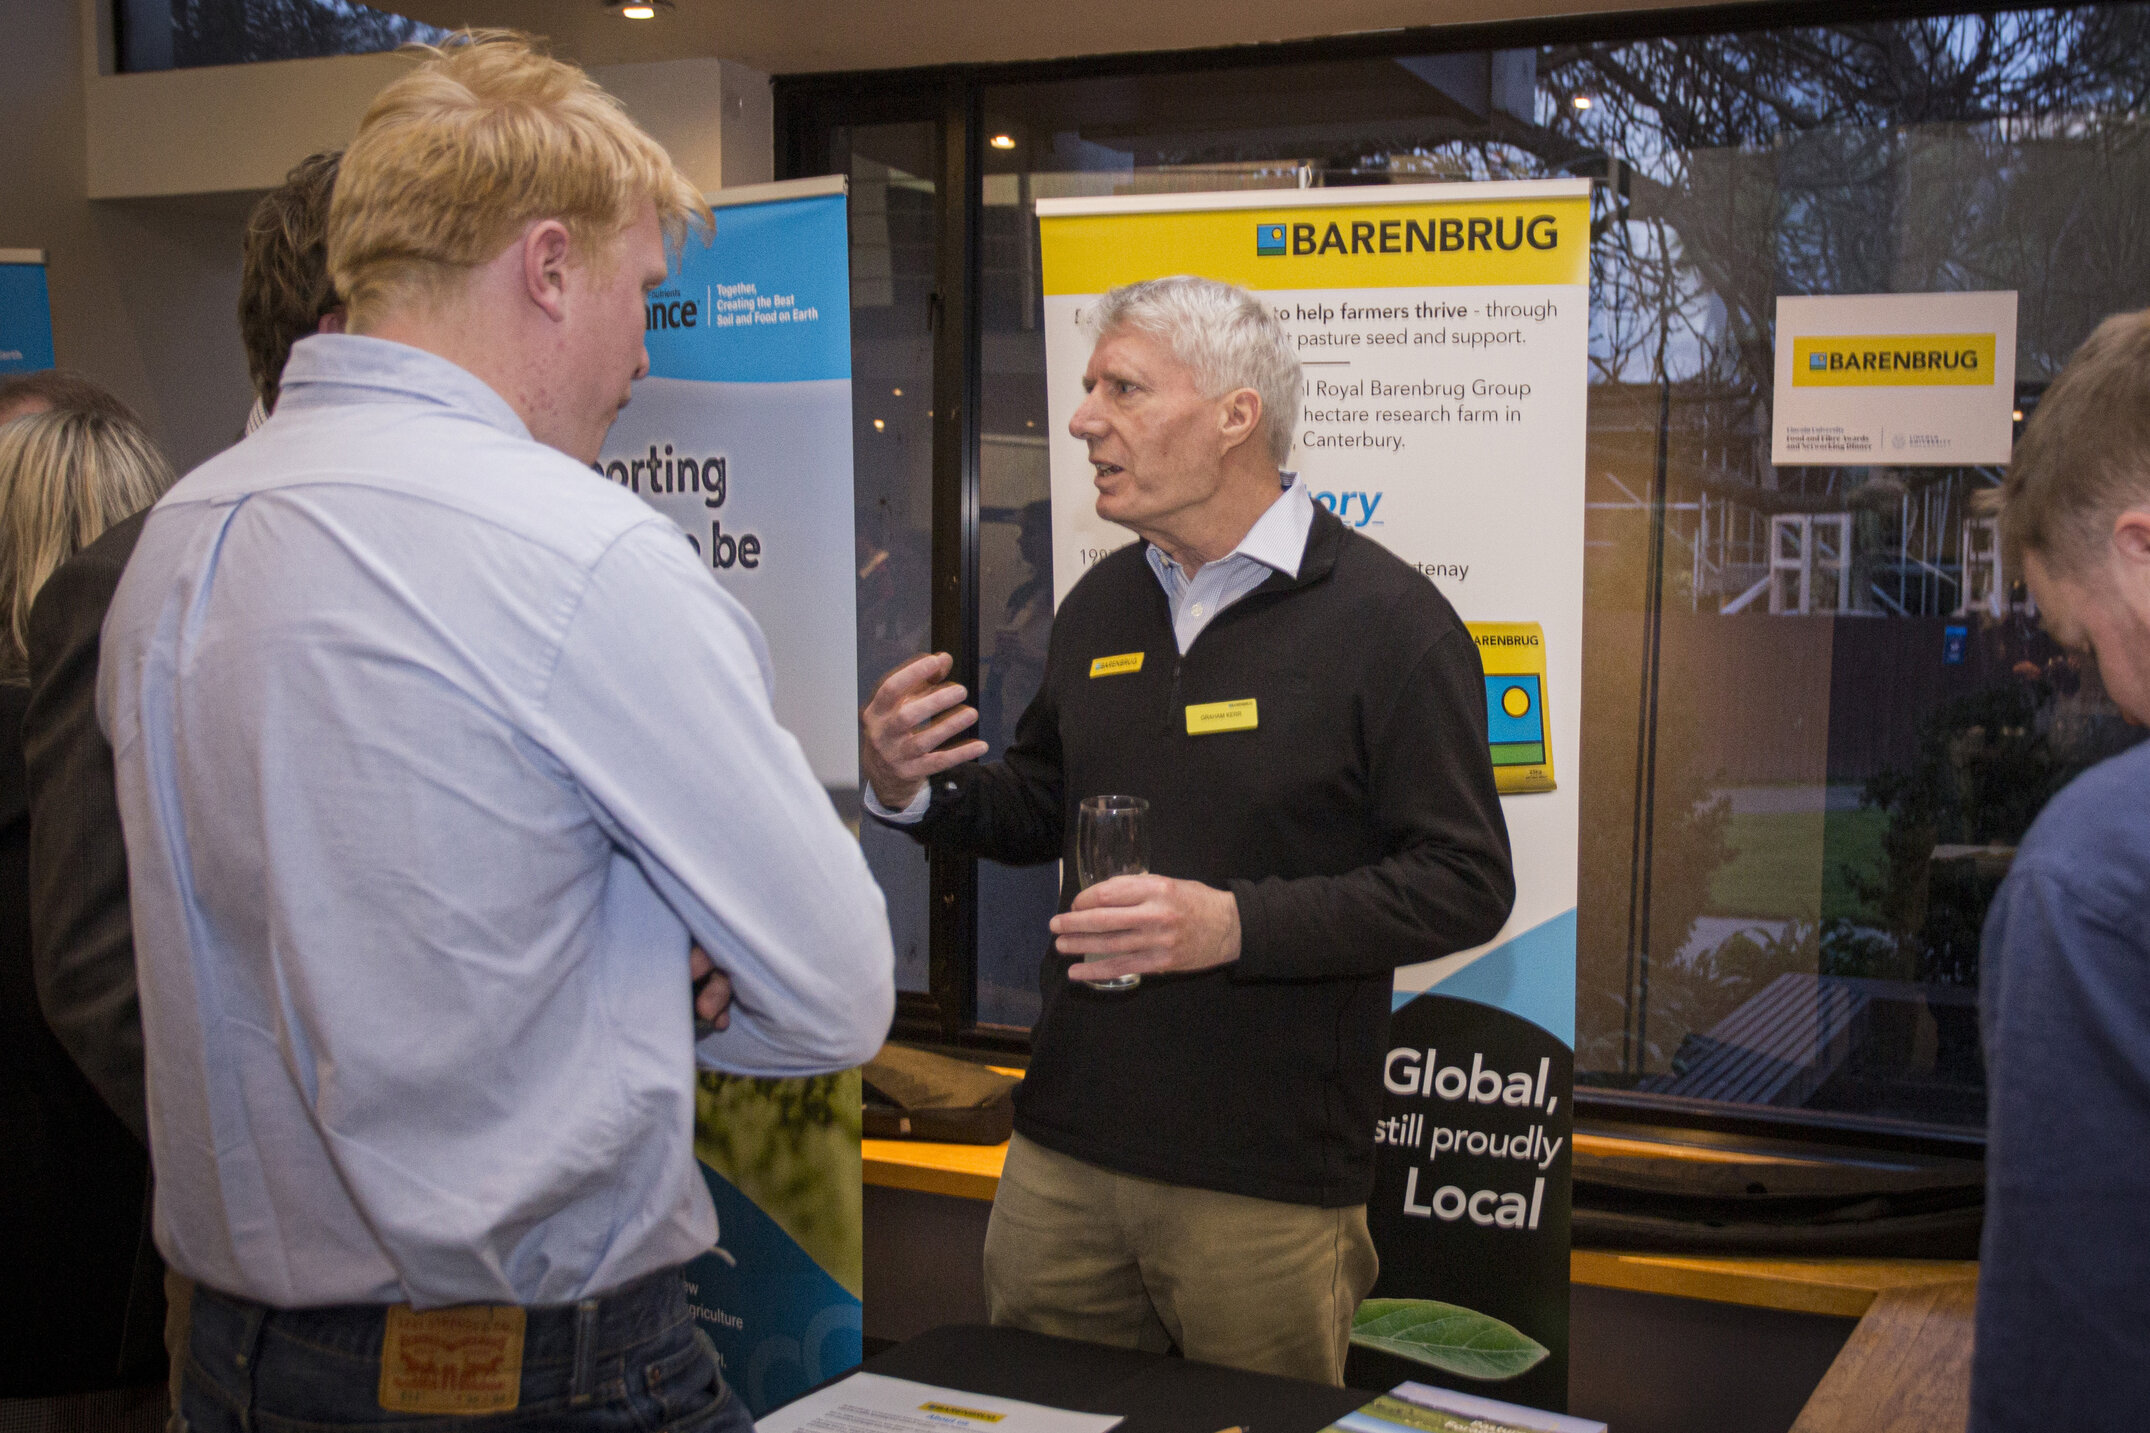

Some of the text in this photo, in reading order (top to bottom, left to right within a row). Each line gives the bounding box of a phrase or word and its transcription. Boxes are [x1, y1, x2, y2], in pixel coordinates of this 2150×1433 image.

[1292, 214, 1558, 256] BARENBRUG
[716, 282, 757, 297] Together,
[716, 294, 795, 312] Creating the Best
[1296, 303, 1334, 323] help
[1340, 302, 1409, 320] farmers
[1414, 300, 1468, 318] thrive
[1485, 298, 1558, 321] through
[646, 299, 698, 331] nce
[716, 307, 818, 327] Soil and Food on Earth
[1297, 330, 1361, 351] pasture
[1366, 327, 1408, 346] seed
[1413, 327, 1446, 345] and
[1451, 328, 1526, 351] support.
[1829, 350, 1978, 371] BARENBRUG
[1316, 379, 1364, 400] Royal
[1371, 379, 1465, 400] Barenbrug
[1472, 378, 1532, 400] Group
[1304, 403, 1521, 422] hectare research farm in
[1303, 430, 1405, 451] Canterbury.
[1786, 442, 1801, 450] and
[1305, 484, 1384, 528] ory
[712, 519, 761, 569] be
[1413, 561, 1470, 582] tenay
[1474, 634, 1539, 646] ARENBRUG
[1200, 712, 1225, 720] GRAHAM
[1383, 1046, 1558, 1116] Global,
[1375, 1112, 1563, 1170] still proudly
[1403, 1166, 1546, 1230] Local
[688, 1303, 744, 1331] griculture
